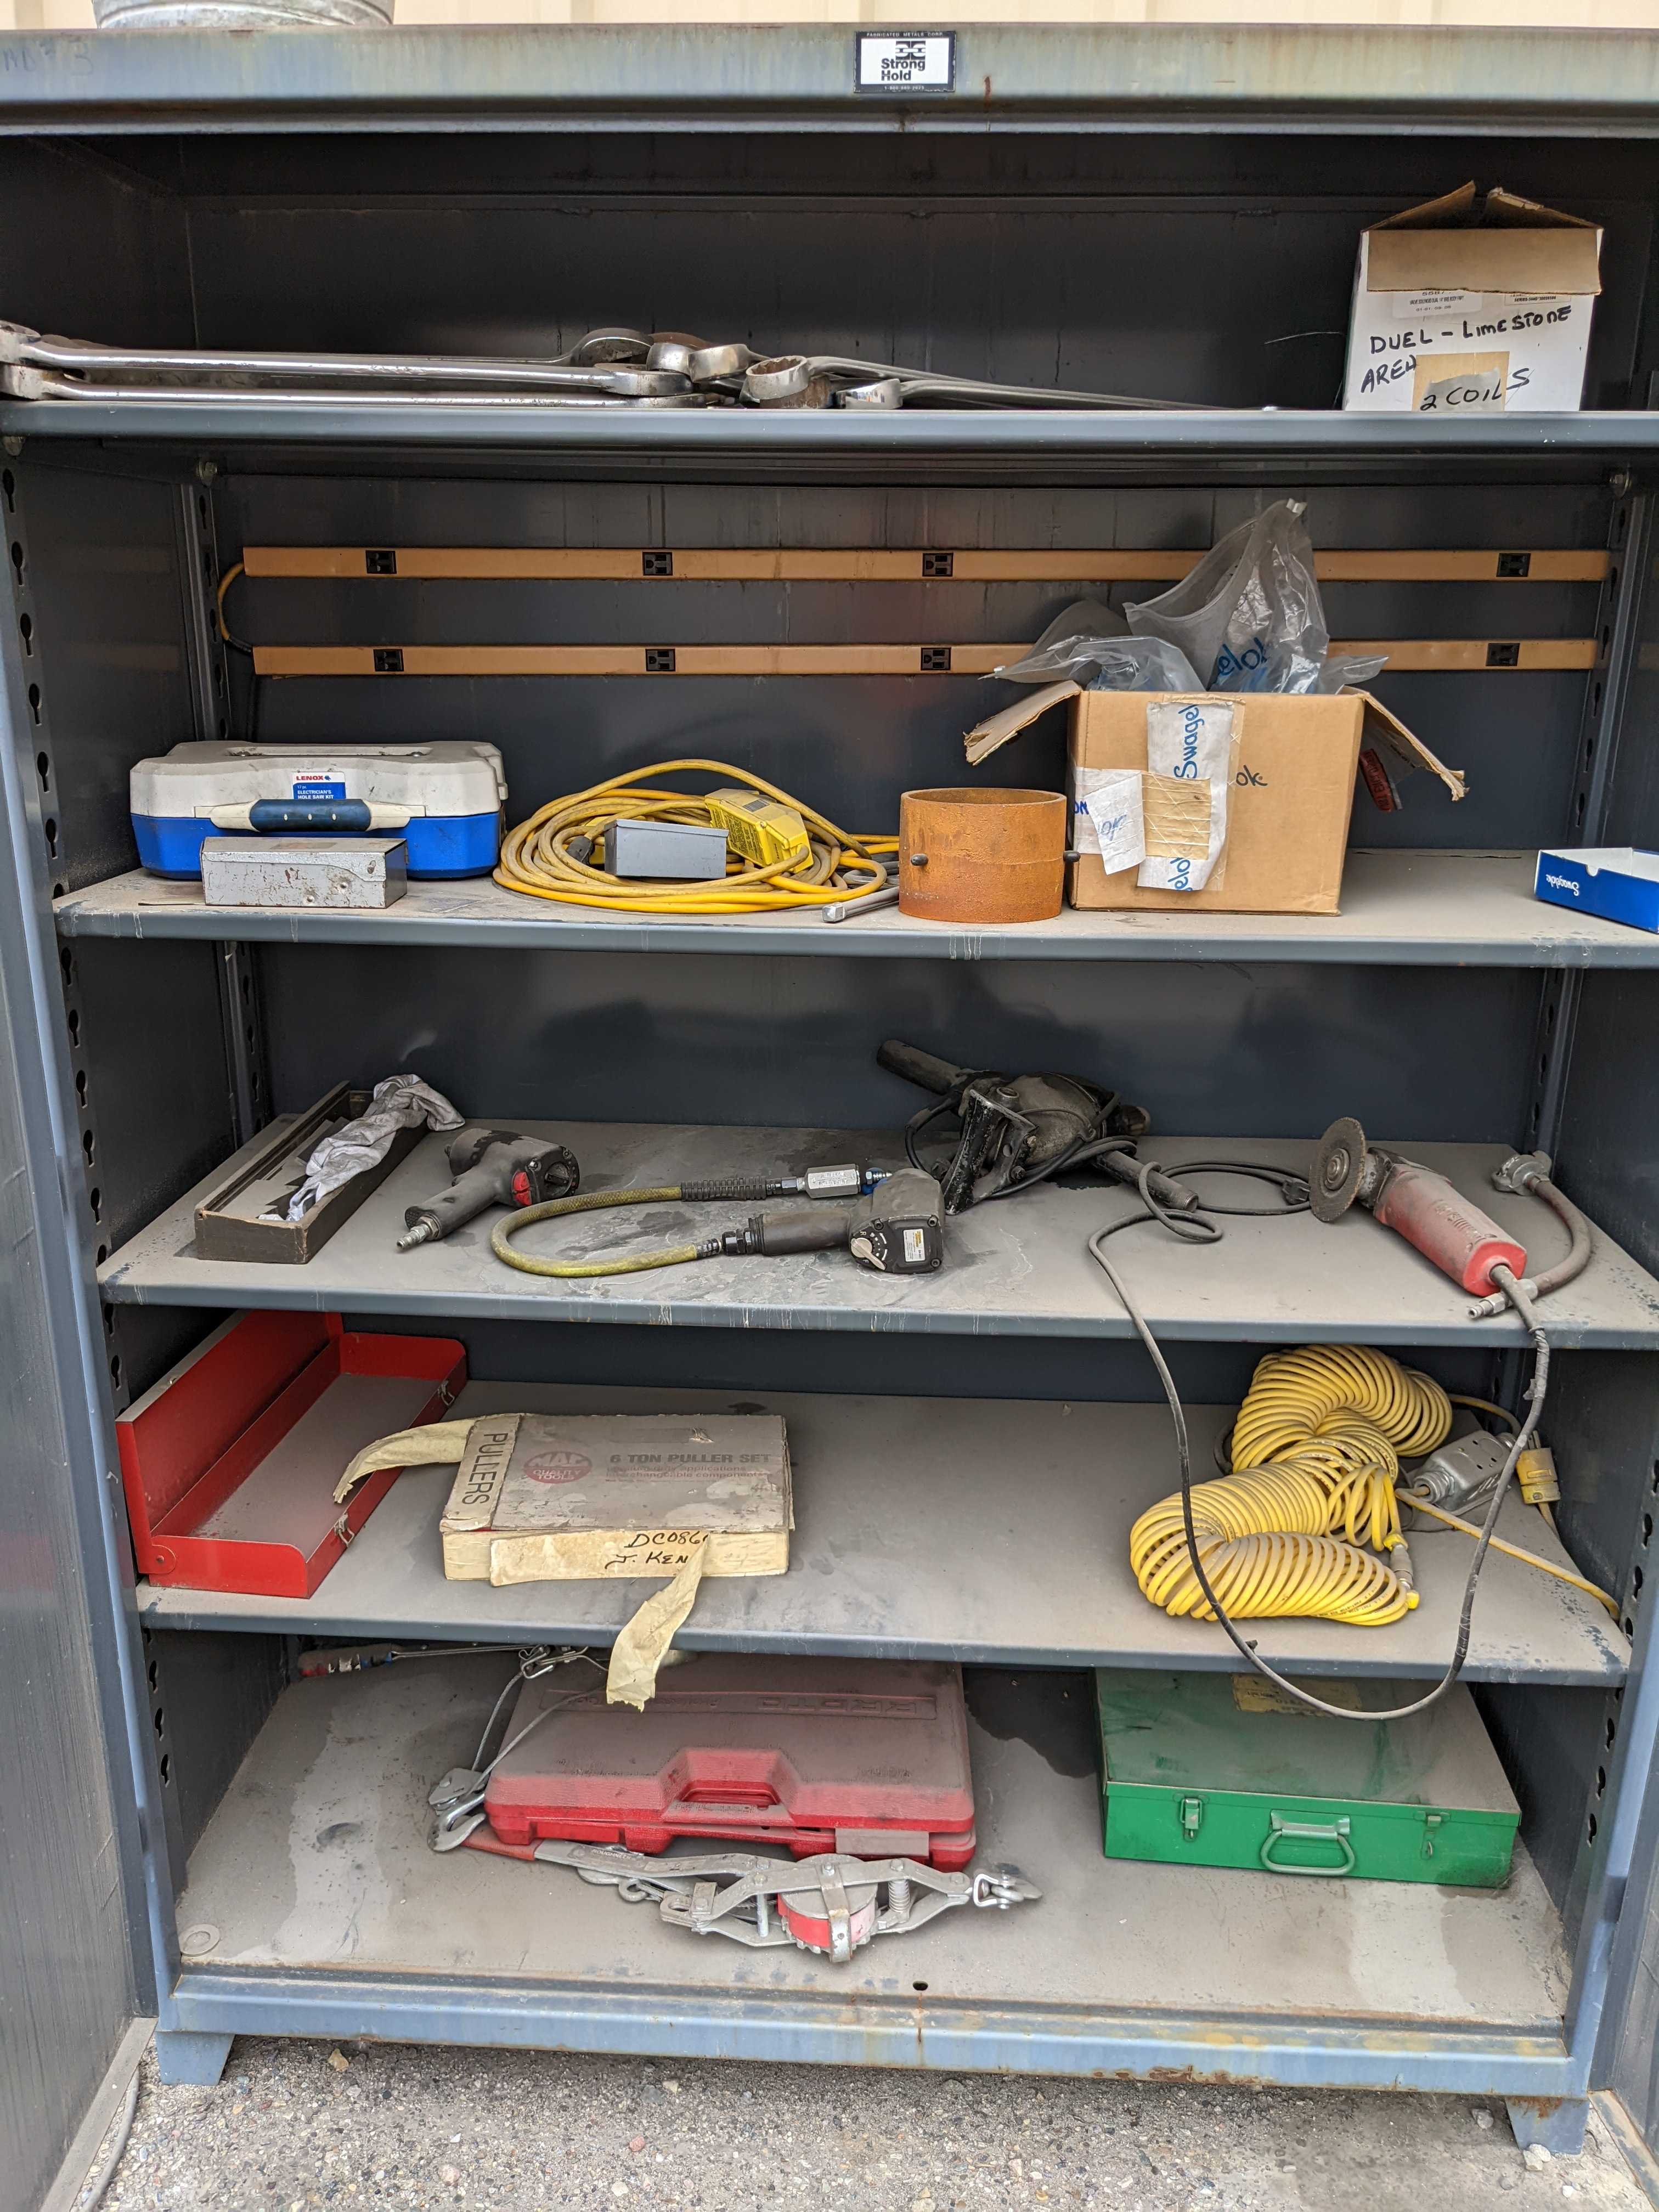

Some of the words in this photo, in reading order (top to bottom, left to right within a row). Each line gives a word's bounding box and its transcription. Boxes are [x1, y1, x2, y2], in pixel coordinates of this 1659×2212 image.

[881, 58, 926, 71] Strong
[881, 70, 911, 81] Hold
[1370, 329, 1432, 354] DUEL
[1420, 394, 1437, 411] 2
[1446, 368, 1531, 407] COILS
[1545, 873, 1580, 897] Swagelok
[462, 1432, 508, 1506] PULLERS
[610, 1454, 621, 1463] 6
[627, 1454, 662, 1463] TON
[668, 1454, 733, 1463] PULLER
[739, 1454, 772, 1463] SET
